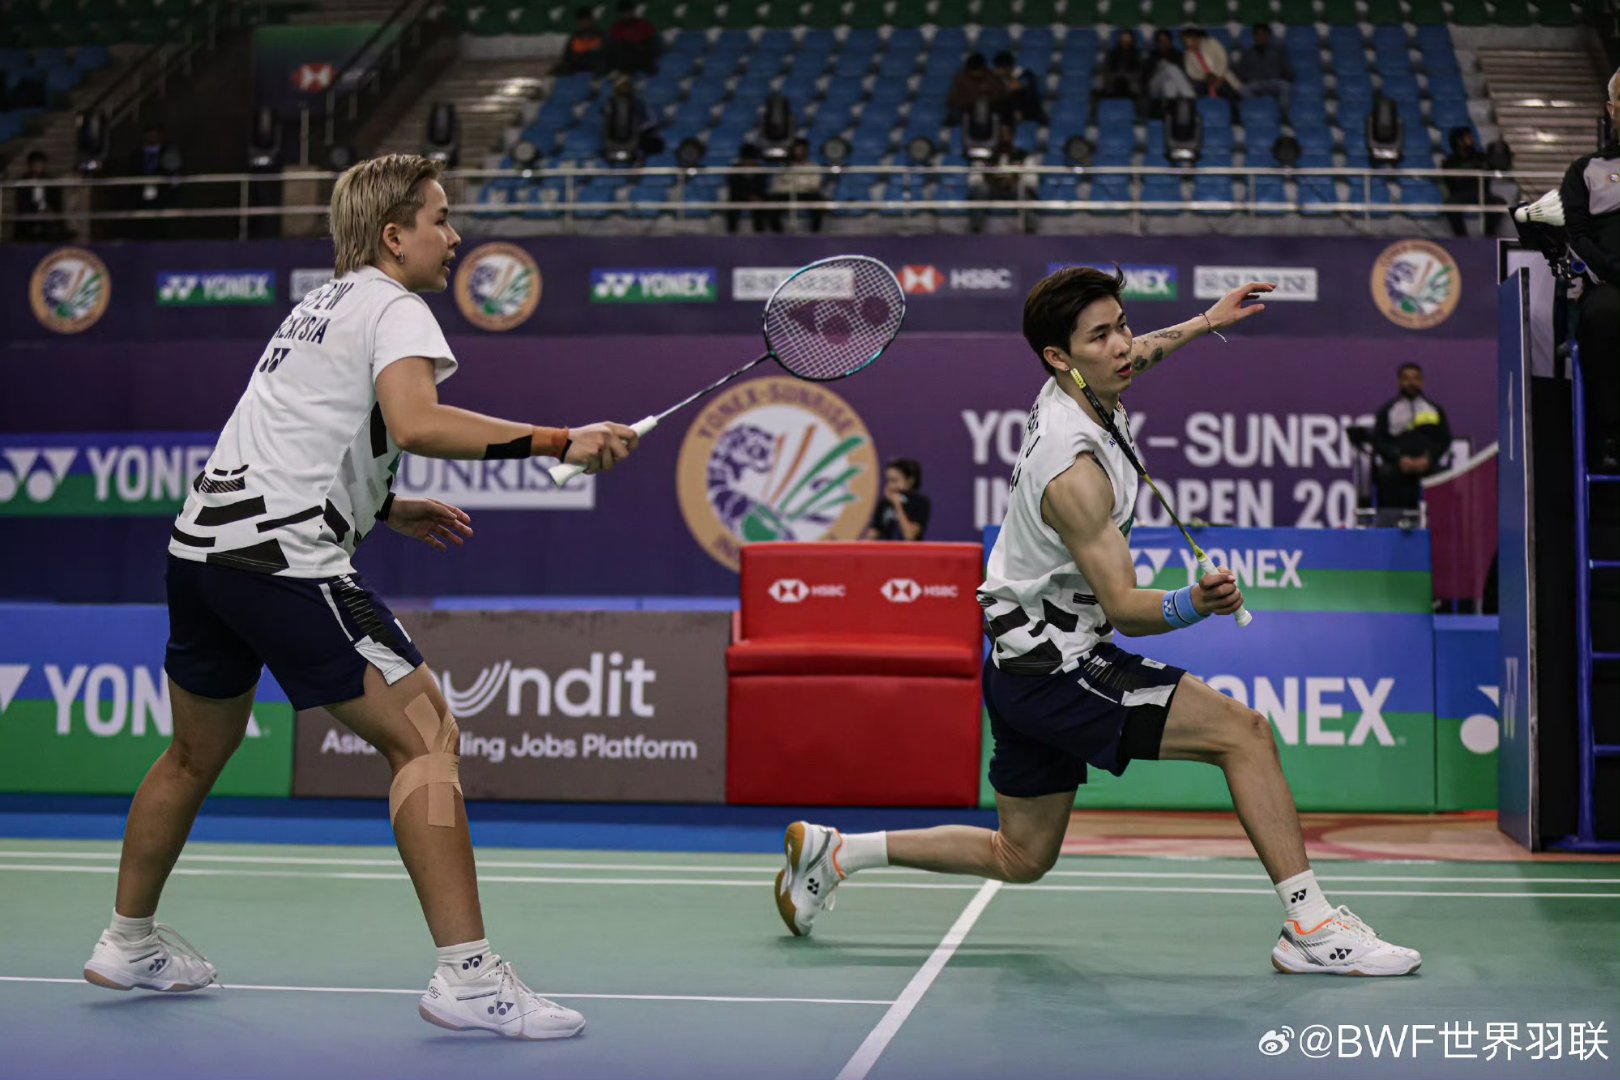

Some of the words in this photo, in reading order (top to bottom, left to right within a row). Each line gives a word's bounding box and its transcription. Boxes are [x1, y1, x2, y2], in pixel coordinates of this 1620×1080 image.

[201, 273, 270, 300] YONEX
[638, 272, 710, 298] YONEX
[950, 268, 1012, 290] HSBC
[86, 446, 213, 502] YONE
[1135, 478, 1275, 529] OPEN
[1292, 478, 1358, 530] 20
[511, 731, 576, 758] Jobs
[582, 731, 698, 760] Platform
